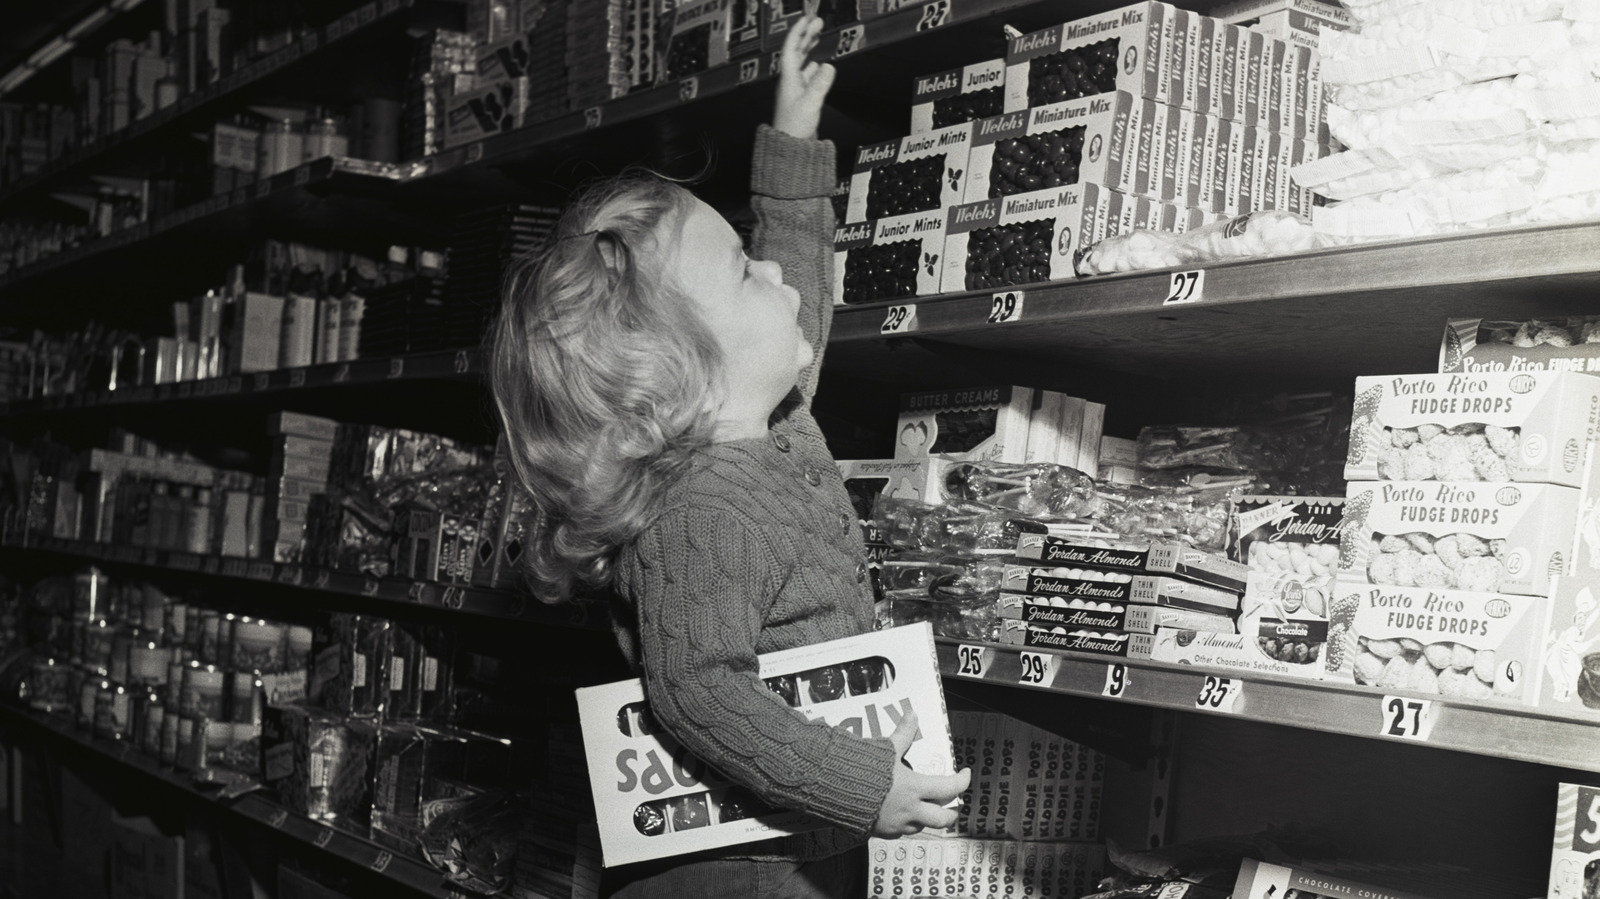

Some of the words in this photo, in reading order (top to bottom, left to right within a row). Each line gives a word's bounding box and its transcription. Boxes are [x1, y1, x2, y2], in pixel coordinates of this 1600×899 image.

[1067, 19, 1119, 40] Miniature
[1121, 10, 1143, 27] Mix
[1164, 17, 1173, 38] Mix
[1334, 10, 1350, 22] Mix
[1013, 29, 1057, 54] Welch's
[1146, 22, 1160, 73] Welch's
[1215, 32, 1223, 53] Mix
[1290, 31, 1319, 49] Miniatu
[1172, 30, 1184, 81] Welch's
[1198, 38, 1211, 88] Welch's
[1263, 45, 1271, 66] Mix
[1284, 53, 1294, 74] Mix
[967, 69, 1001, 87] Junior
[1160, 41, 1171, 94] Miniature
[1186, 49, 1196, 101] Miniature
[1223, 46, 1235, 96] Welch's
[1311, 61, 1321, 82] Mix
[916, 73, 958, 96] Welch's
[1211, 53, 1222, 108] Miniature
[1237, 61, 1246, 114] Miniature
[1248, 55, 1260, 104] Welch's
[1269, 62, 1281, 111] Welch's
[1260, 68, 1269, 120] Miniature
[1283, 75, 1292, 127] Miniature
[1295, 69, 1307, 117] Welch's
[1033, 107, 1087, 126] Miniature
[1089, 99, 1111, 115] Mix
[1309, 82, 1318, 134] Miniature
[980, 116, 1023, 136] Welch's
[1131, 109, 1139, 131] Mix
[1155, 115, 1164, 137] Mix
[903, 139, 936, 155] Junior
[938, 131, 967, 147] Mints
[1110, 111, 1127, 163] Welch's
[1138, 122, 1151, 173] Welch's
[1207, 127, 1215, 148] Mix
[857, 145, 896, 164] Welch's
[1165, 128, 1178, 180] Welch's
[1190, 136, 1203, 186] Welch's
[1281, 146, 1289, 166] Mix
[1214, 143, 1227, 191] Welch's
[1240, 148, 1253, 197] Welch's
[1265, 155, 1277, 203] Welch's
[955, 202, 996, 223] Welch's
[1005, 197, 1055, 215] Miniature
[1057, 193, 1079, 208] Mix
[1098, 199, 1108, 220] Mix
[879, 220, 911, 238] Junior
[913, 216, 942, 233] Mints
[1123, 206, 1132, 227] Mix
[834, 222, 871, 244] Welch's
[1166, 271, 1199, 302] 27
[1463, 356, 1504, 372] Porto
[1510, 356, 1544, 372] Rico
[1548, 358, 1585, 371] FUDGE
[1392, 376, 1435, 397] Porto
[1448, 375, 1488, 395] Rico
[909, 394, 949, 408] BUTTER
[954, 389, 999, 404] CREAMS
[1411, 399, 1457, 414] FUDGE
[1462, 397, 1513, 414] DROPS
[1382, 483, 1425, 503] Porto
[1436, 482, 1475, 503] Rico
[1308, 506, 1332, 515] THIN
[1401, 506, 1445, 522] FUDGE
[1451, 508, 1499, 525] DROPS
[1269, 516, 1325, 542] Jordan
[1047, 545, 1086, 560] Jordan
[1084, 550, 1142, 567] Almonds
[1150, 558, 1172, 568] SHELL
[1155, 549, 1171, 558] THIN
[1032, 577, 1070, 592] Jordan
[1069, 582, 1124, 598] Almonds
[1134, 590, 1154, 599] SHELL
[1138, 580, 1154, 589] THIN
[1370, 588, 1413, 609] Porto
[1424, 592, 1465, 613] Rico
[1028, 606, 1065, 621] Jordan
[1064, 611, 1119, 628] Almonds
[1127, 620, 1148, 629] SHELL
[1132, 610, 1148, 619] THIN
[1387, 612, 1433, 630] FUDGE
[1439, 617, 1488, 637] DROPS
[1031, 630, 1067, 644] Jordan
[1066, 635, 1122, 653] Almonds
[1136, 635, 1151, 644] THIN
[1276, 625, 1308, 636] Chocolate
[1131, 645, 1152, 655] SHELL
[1194, 654, 1213, 664] Other
[1216, 657, 1250, 668] Chocolate
[1253, 661, 1288, 673] Selections
[981, 738, 995, 776] POPS
[1001, 739, 1015, 776] POPS
[1028, 741, 1042, 779] POPS
[1045, 742, 1059, 779] POPS
[1060, 742, 1073, 780] POPS
[1092, 754, 1104, 782] POP
[976, 781, 991, 834] KIDDIE
[995, 781, 1010, 835] KIDDIE
[1022, 784, 1037, 837] KIDDIE
[1040, 785, 1054, 837] KIDDIE
[1055, 785, 1069, 837] KIDDIE
[1070, 786, 1085, 838] KIDDIE
[1299, 877, 1351, 894] CHOCOLATE
